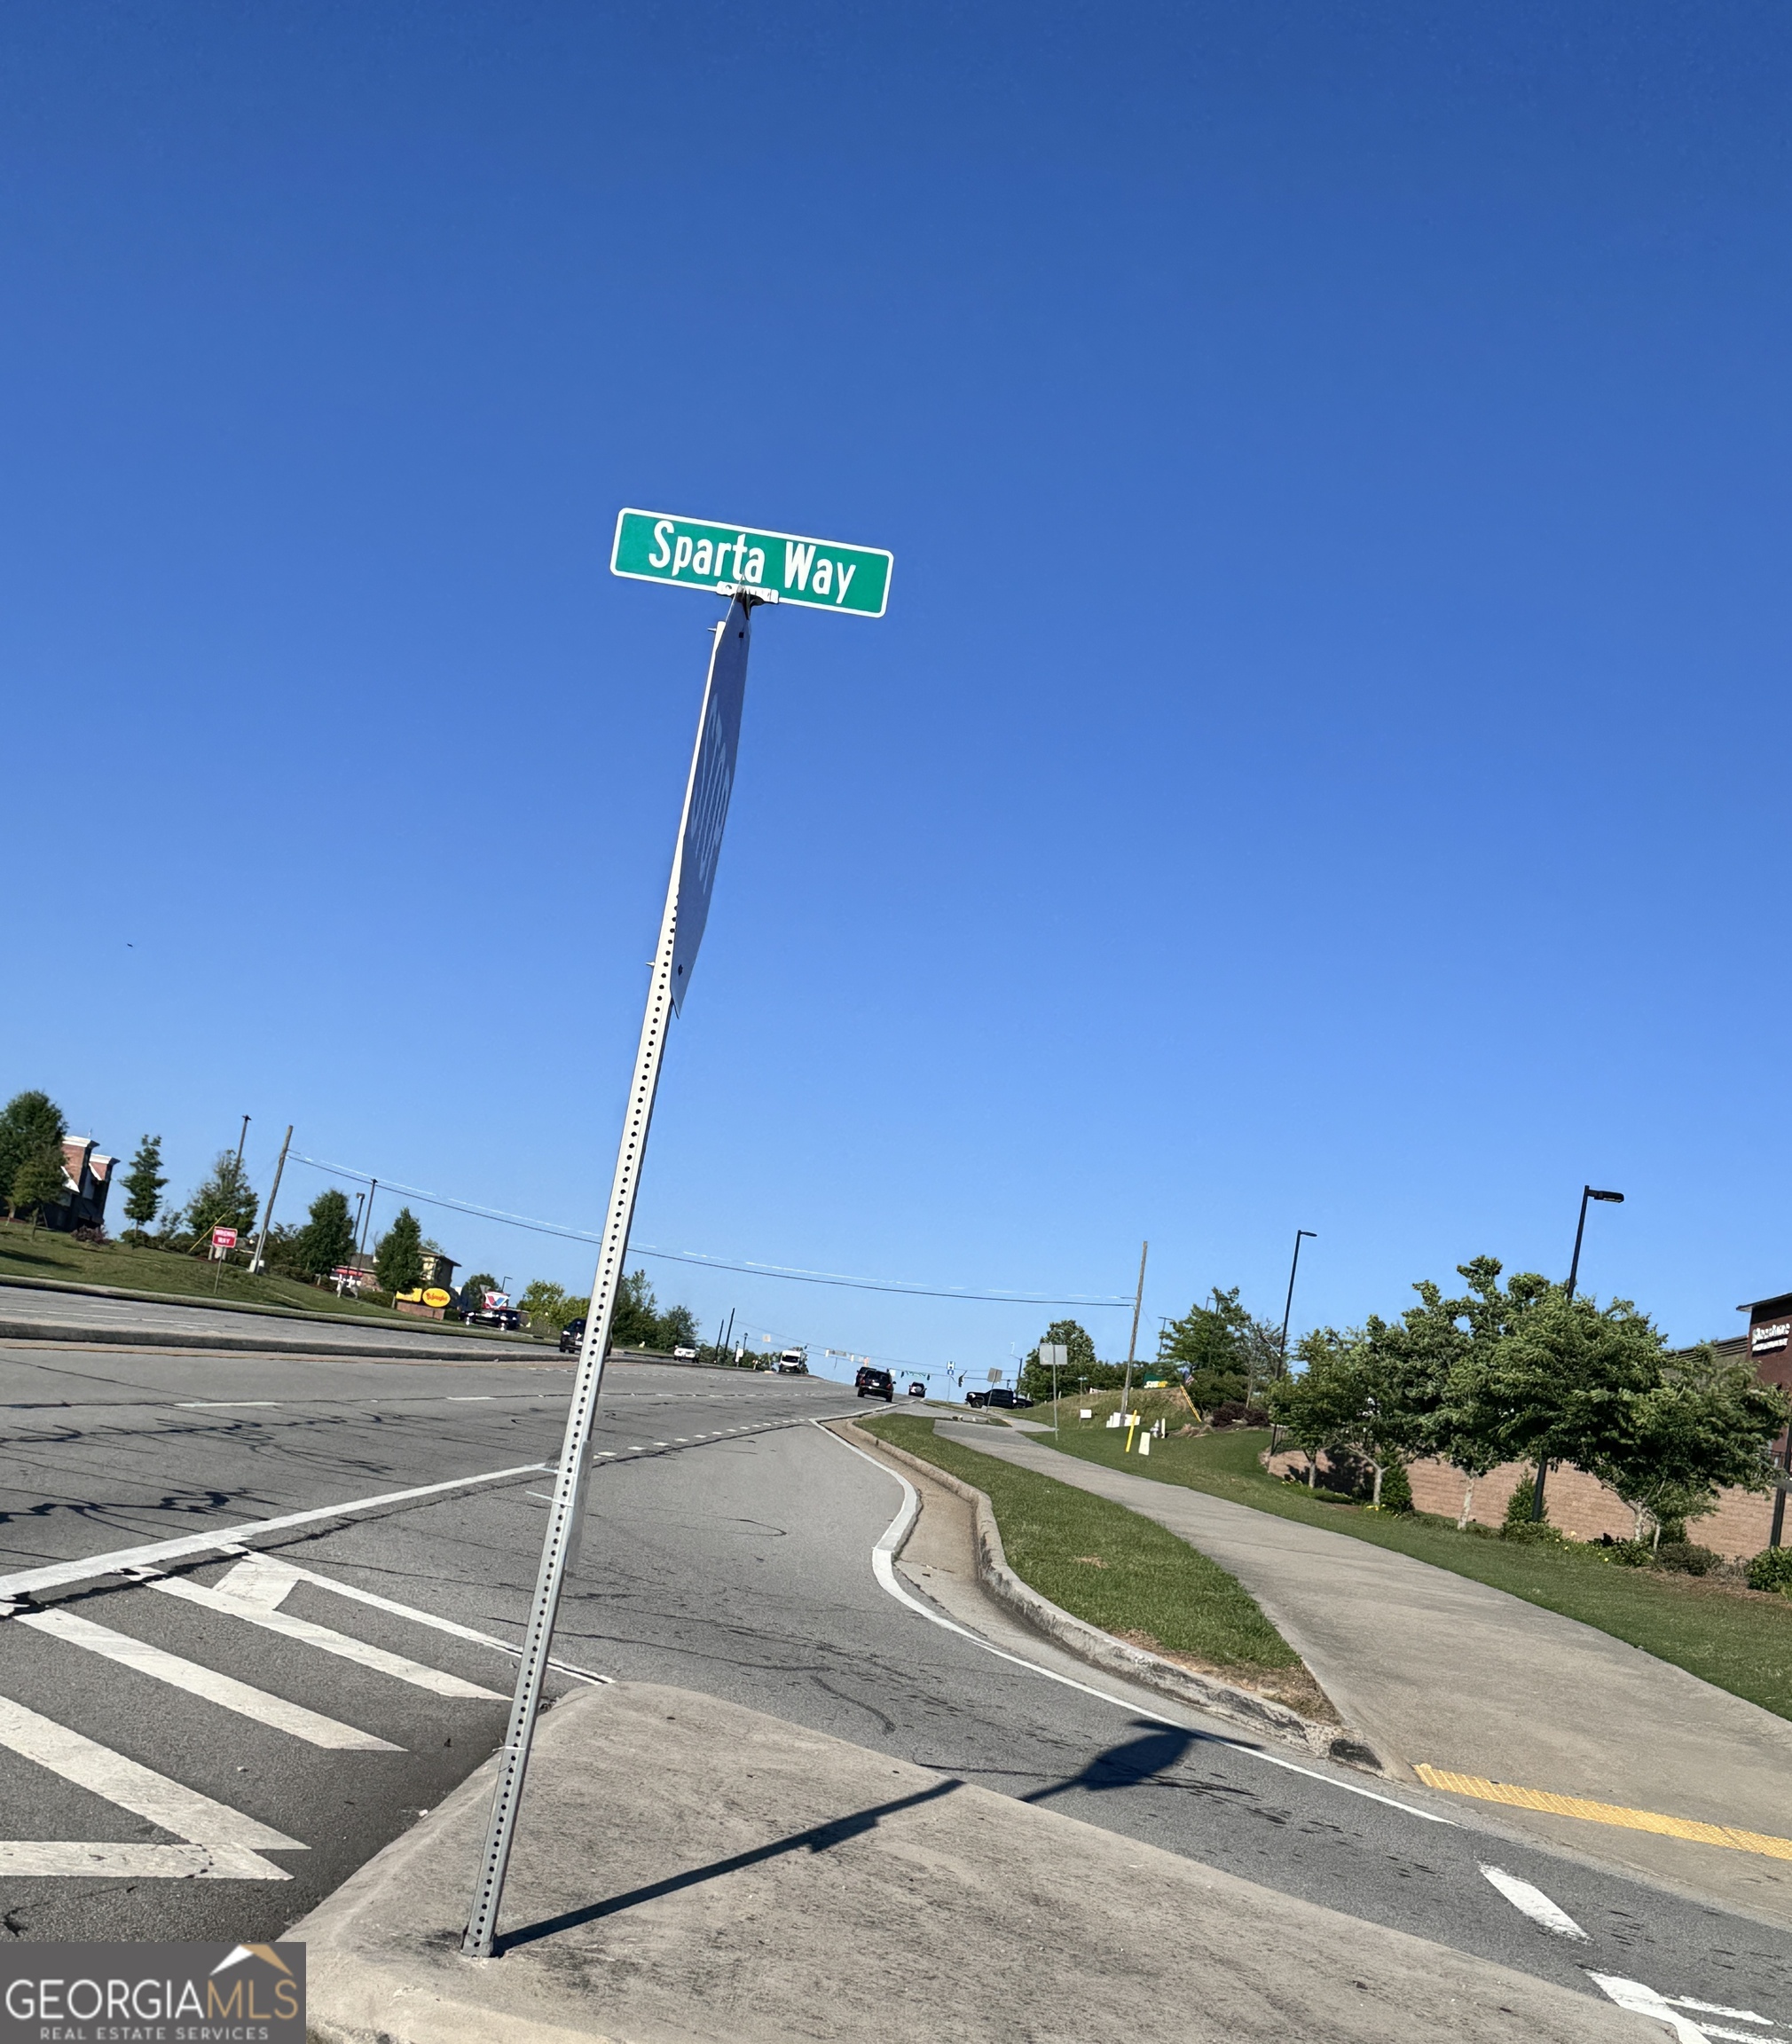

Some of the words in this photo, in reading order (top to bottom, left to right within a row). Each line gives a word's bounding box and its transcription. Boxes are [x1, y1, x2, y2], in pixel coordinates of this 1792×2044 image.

[648, 520, 766, 584] Sparta
[784, 540, 857, 605] Way
[691, 693, 731, 895] STOP
